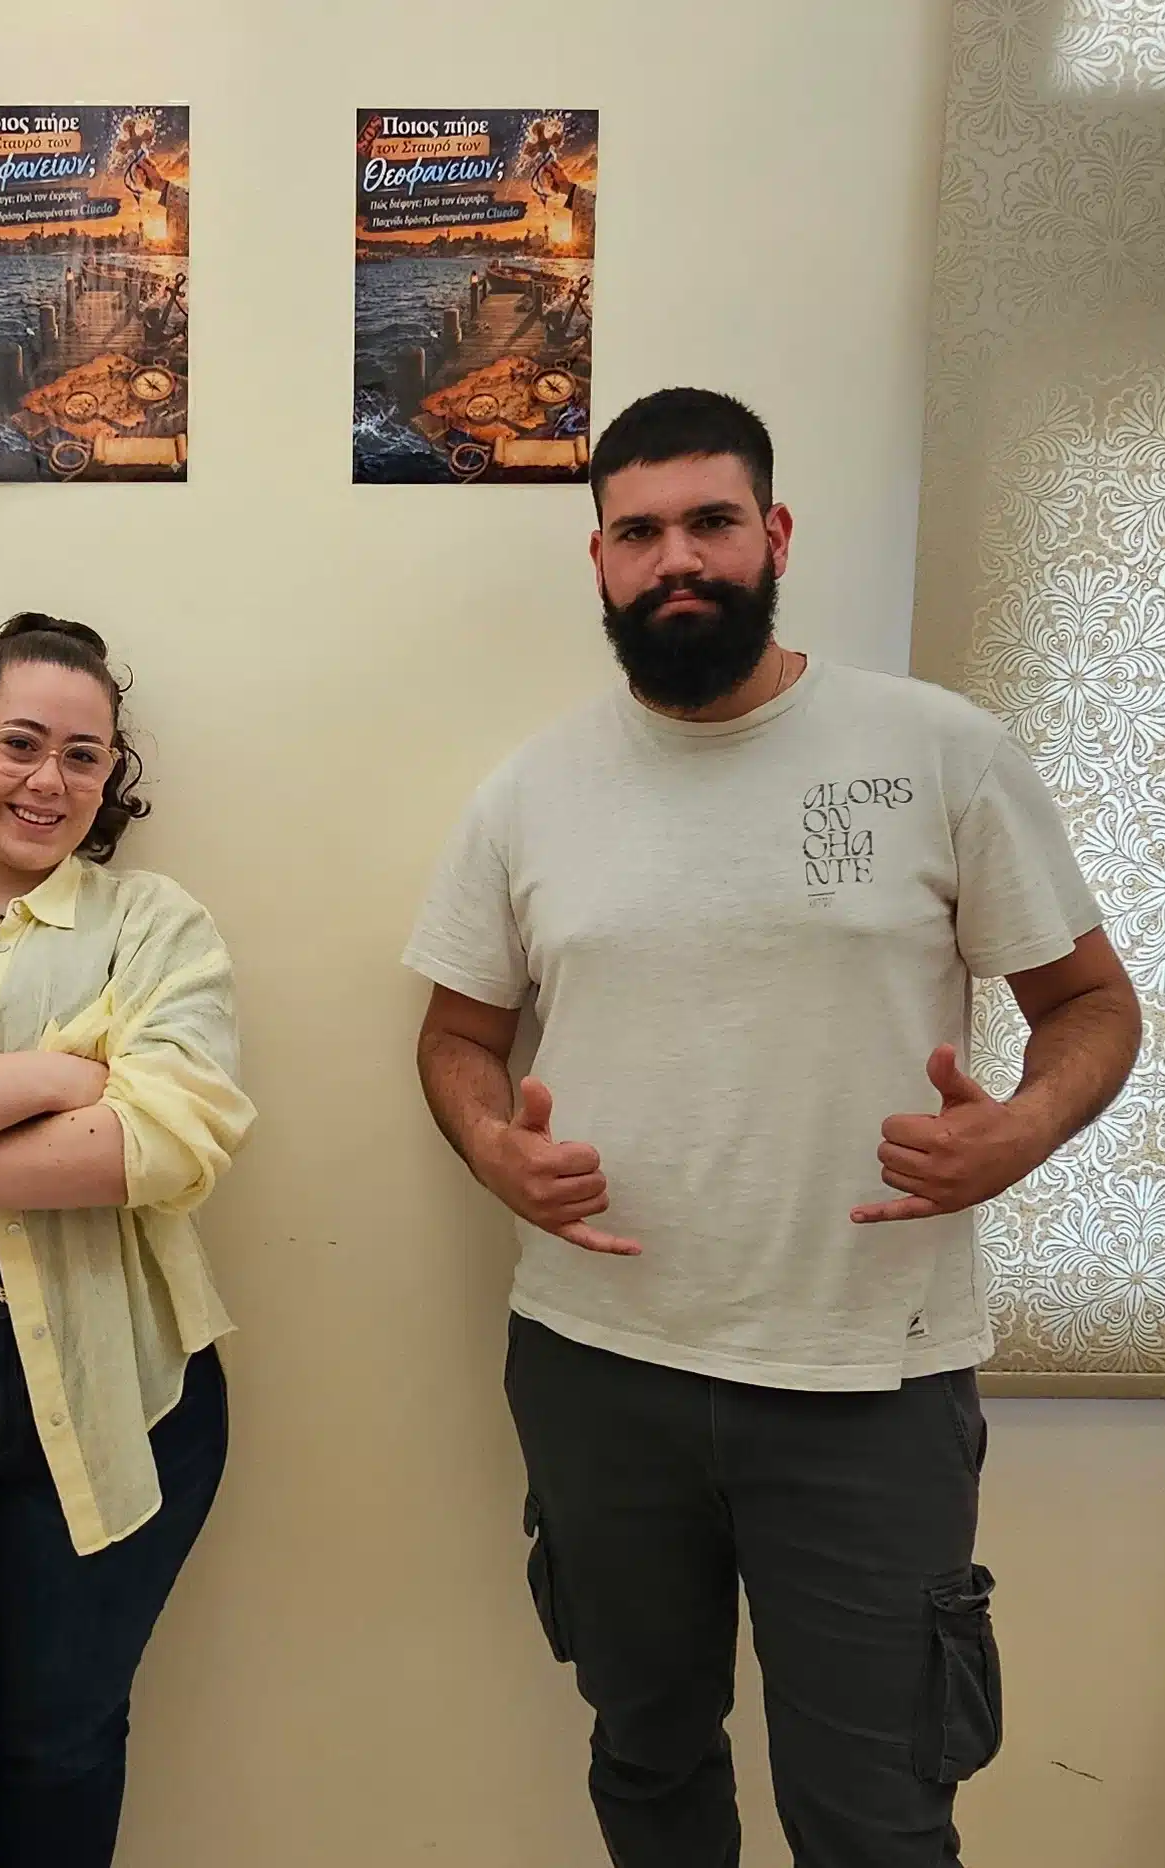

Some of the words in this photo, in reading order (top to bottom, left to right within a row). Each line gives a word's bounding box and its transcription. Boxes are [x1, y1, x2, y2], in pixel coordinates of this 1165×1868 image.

[34, 112, 80, 134] πήρε
[382, 116, 439, 138] Ποιος
[443, 116, 489, 138] πήρε
[48, 138, 72, 149] των
[375, 143, 399, 155] τον
[400, 139, 451, 155] Σταυρό
[456, 141, 481, 152] των
[363, 155, 505, 195] Θεοφανείων;
[803, 777, 914, 809] ALORS
[803, 805, 852, 833] ON
[805, 857, 874, 885] NTE
